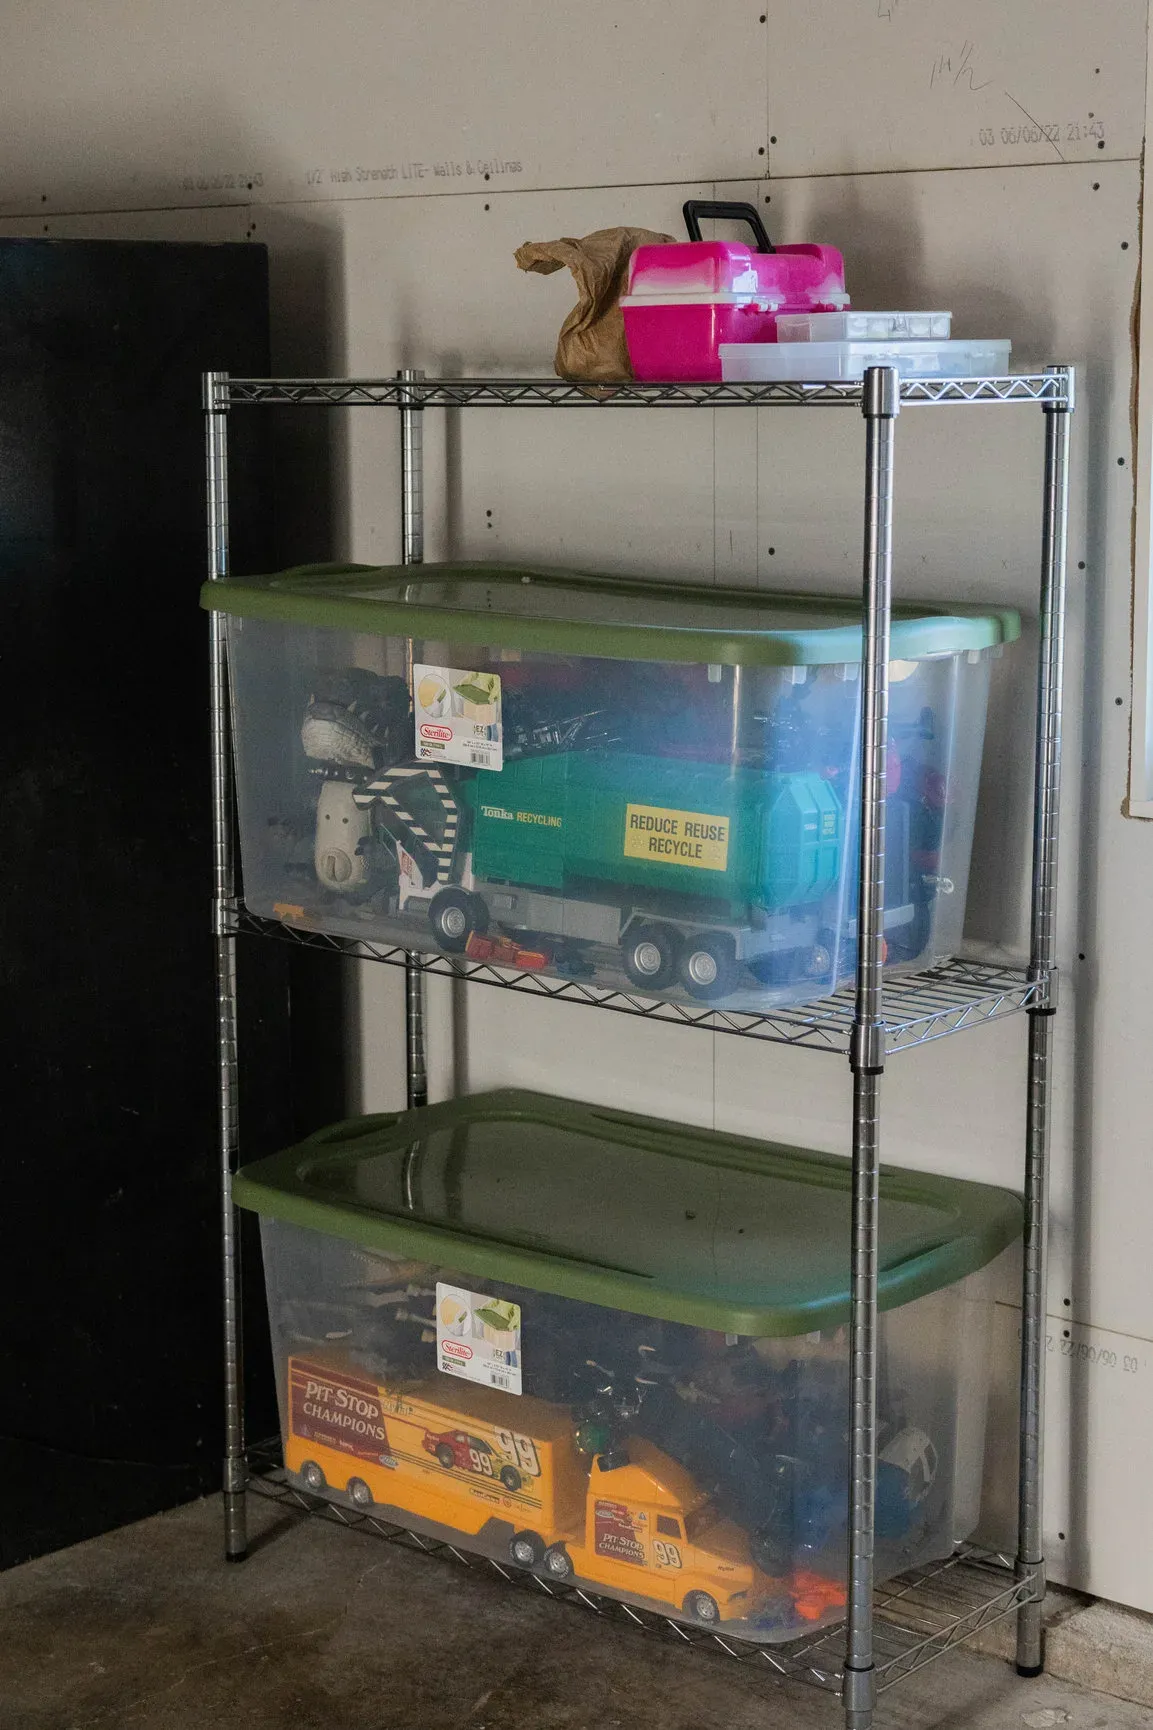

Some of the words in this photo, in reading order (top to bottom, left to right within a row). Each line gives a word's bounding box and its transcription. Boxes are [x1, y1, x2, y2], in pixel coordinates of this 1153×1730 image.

[978, 127, 995, 147] 03
[1066, 121, 1105, 142] 21:43
[355, 164, 399, 182] Strength
[433, 160, 463, 178] Walls
[466, 160, 476, 176] &
[423, 726, 451, 740] Sterilite
[481, 805, 514, 820] Tonka
[516, 811, 562, 828] RECYCLING
[630, 813, 678, 835] REDUCE
[684, 822, 726, 842] REUSE
[648, 837, 703, 859] RECYCLE
[444, 1342, 471, 1357] Sterilite
[305, 1380, 333, 1403] PIT
[334, 1388, 379, 1420] STOP
[302, 1402, 386, 1441] CHAMPIONS
[469, 1447, 493, 1477] 99
[495, 1425, 541, 1477] 99
[598, 1542, 645, 1559] CHAMPIONS
[602, 1532, 618, 1543] PIT
[618, 1536, 644, 1552] STOP
[652, 1539, 683, 1568] 99
